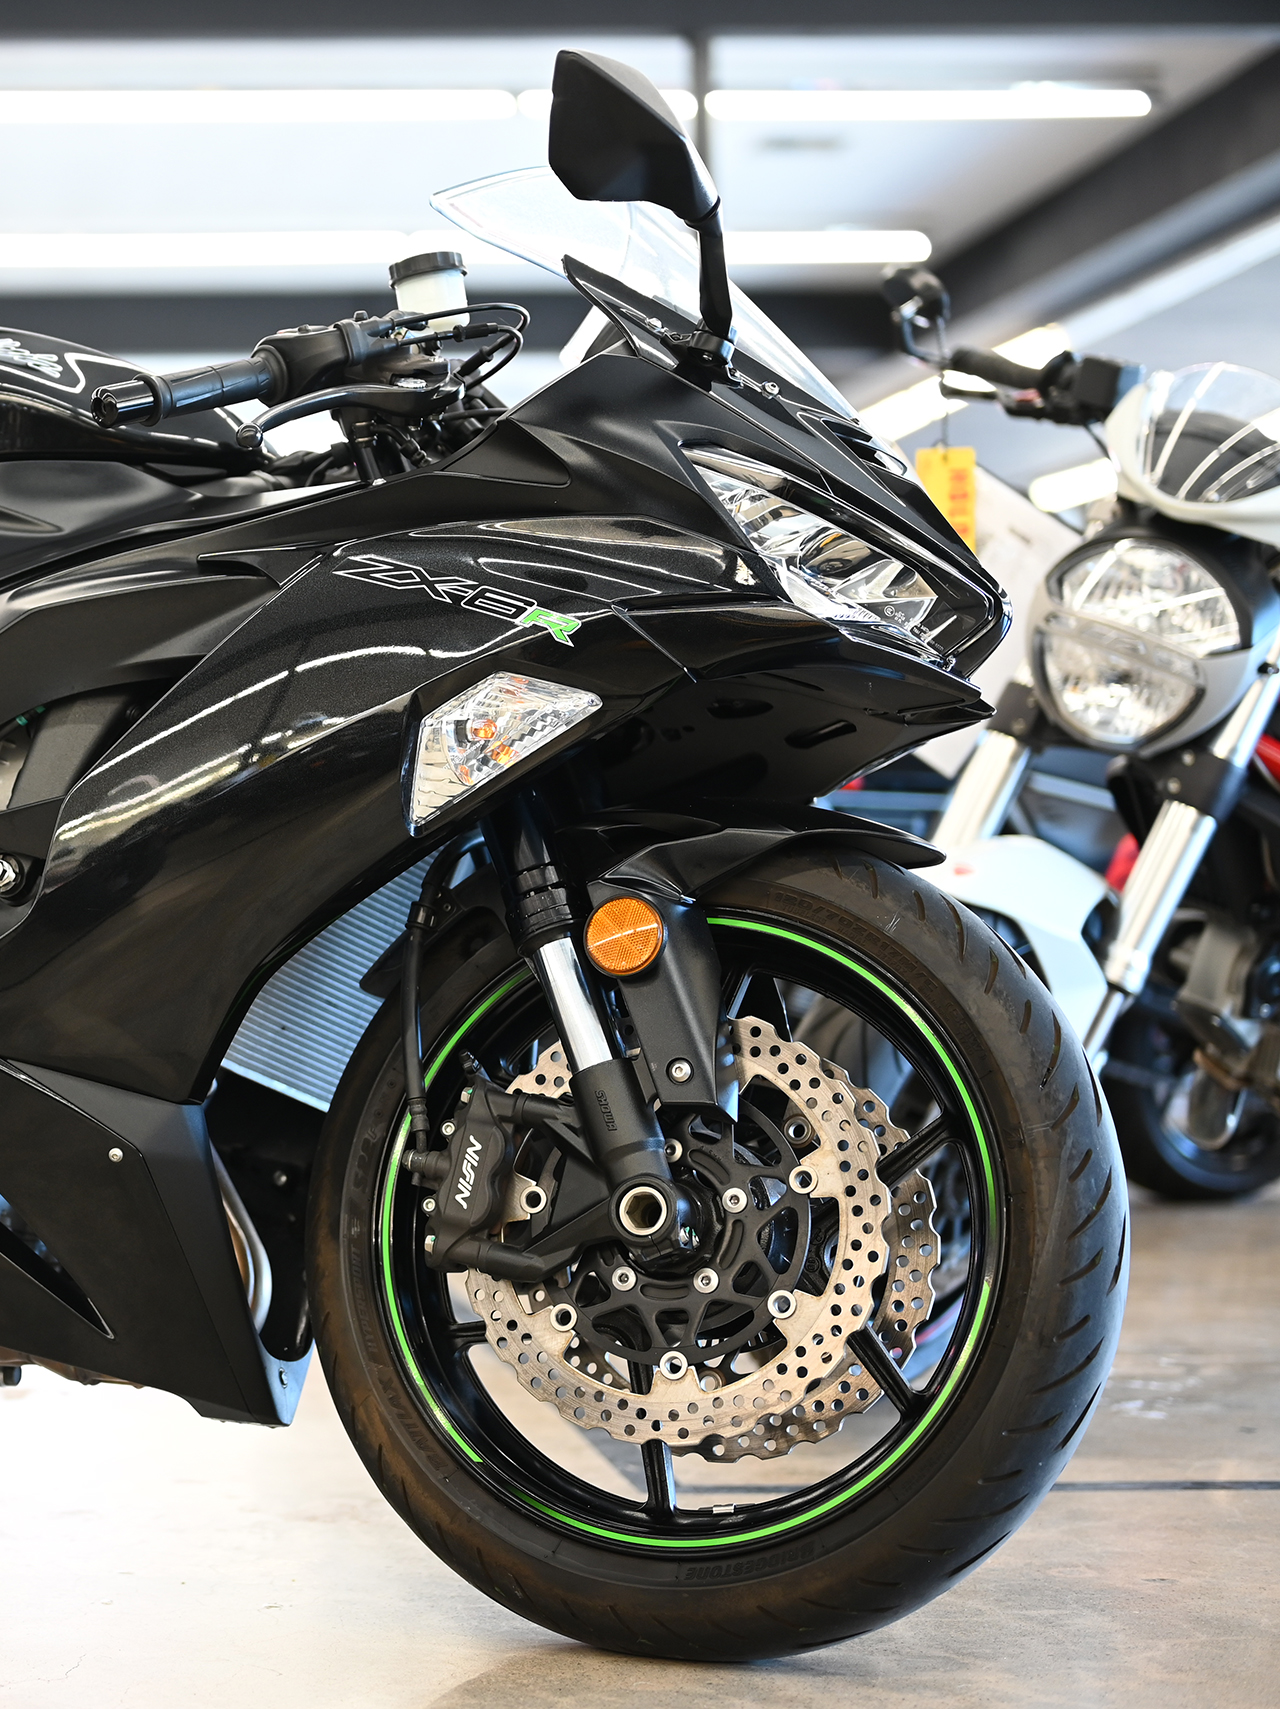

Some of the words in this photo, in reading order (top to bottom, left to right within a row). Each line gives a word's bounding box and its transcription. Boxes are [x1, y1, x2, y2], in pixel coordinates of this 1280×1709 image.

[594, 1089, 618, 1132] SHOWA
[455, 1135, 482, 1210] NISSIN
[685, 1540, 817, 1581] BRIDGESTONE
